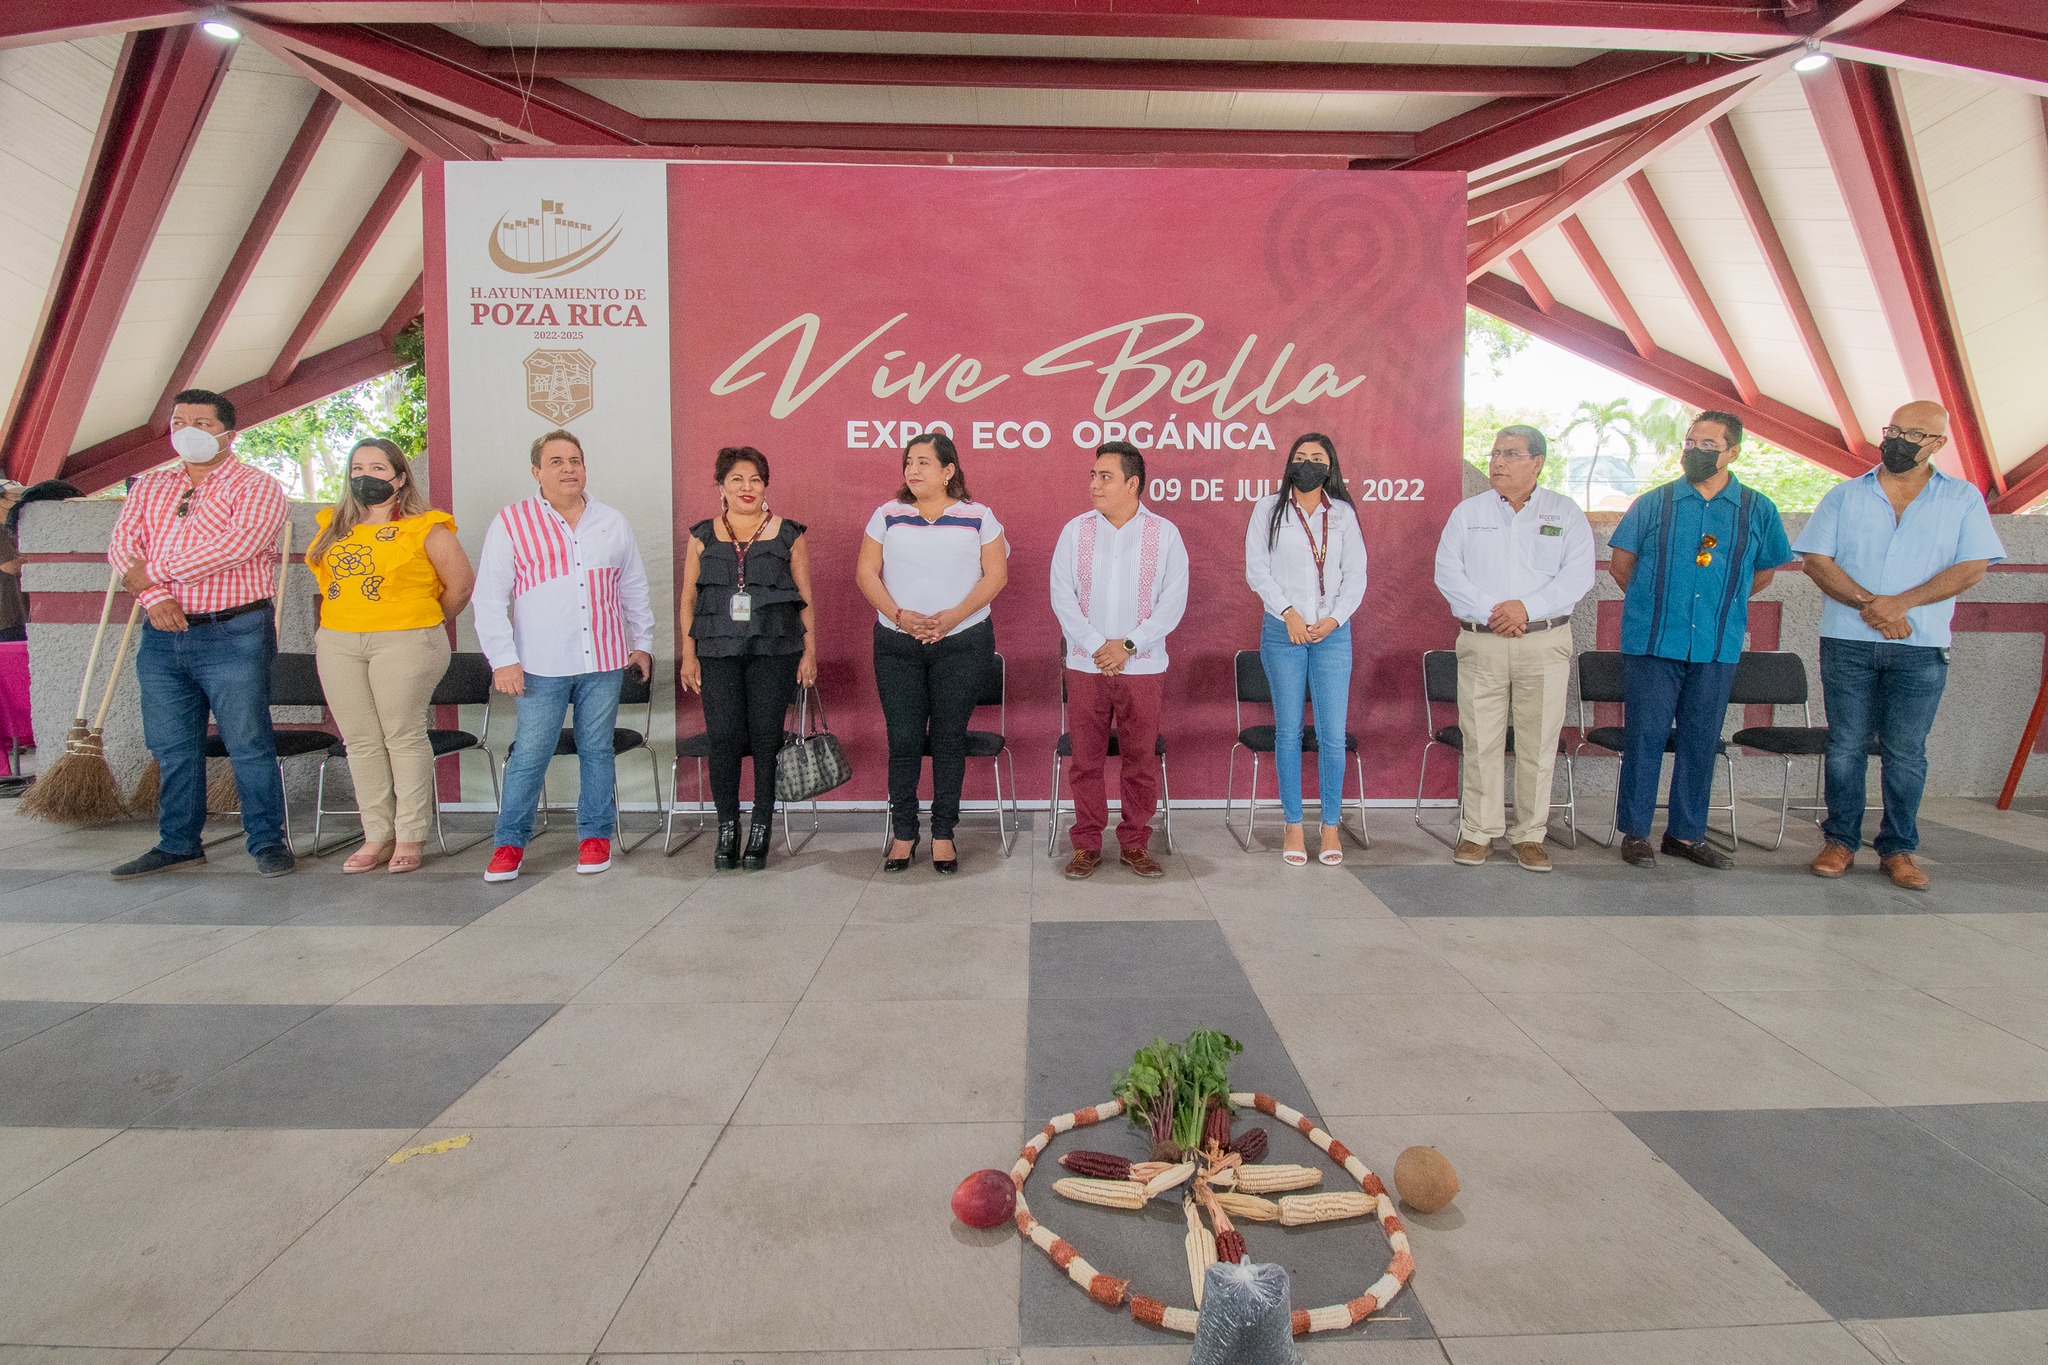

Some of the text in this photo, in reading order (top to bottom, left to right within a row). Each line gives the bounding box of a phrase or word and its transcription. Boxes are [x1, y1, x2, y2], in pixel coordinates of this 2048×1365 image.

[470, 286, 647, 300] H.AYUNTAMIENTO DE
[470, 303, 648, 327] POZA RICA
[533, 331, 584, 340] 2022-2025
[709, 312, 1367, 421] Vive Bella
[972, 421, 1052, 449] ECO
[1072, 413, 1276, 450] ORGÁNICA
[1149, 478, 1182, 501] 09
[1191, 479, 1224, 501] DE
[1362, 478, 1425, 501] 2022
